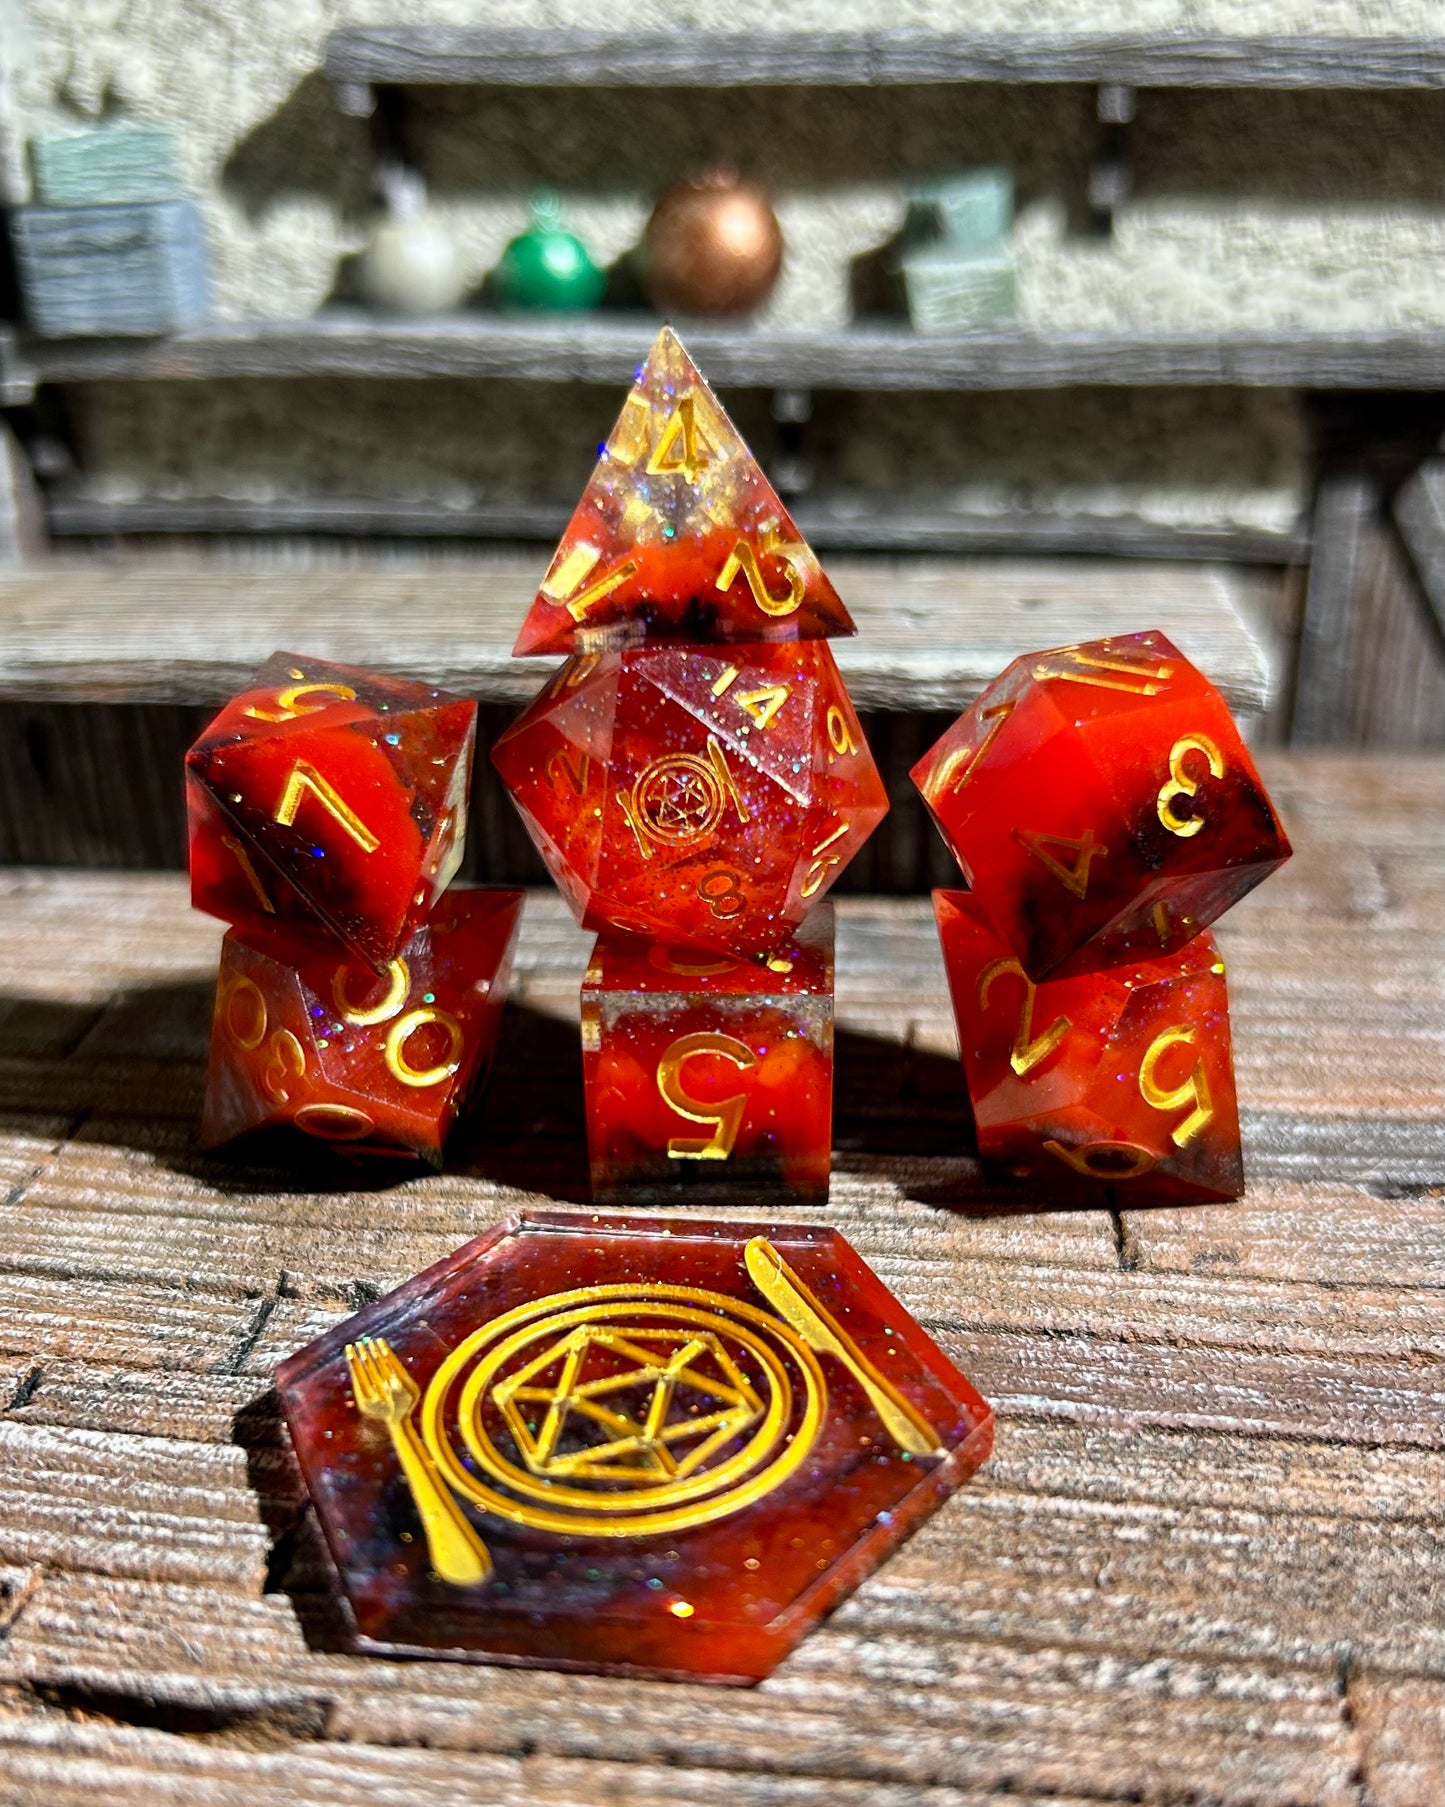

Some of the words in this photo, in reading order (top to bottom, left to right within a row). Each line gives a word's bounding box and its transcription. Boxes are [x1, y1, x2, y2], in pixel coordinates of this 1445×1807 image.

[647, 397, 709, 485] 4
[715, 539, 806, 617] 2
[242, 683, 357, 723] 5
[273, 759, 381, 854] 7
[1157, 733, 1224, 838] 3
[696, 869, 747, 919] 8
[1011, 827, 1109, 899] 4
[976, 956, 1074, 1077] 2
[657, 1031, 758, 1161] 5
[1139, 1024, 1213, 1148] 5
